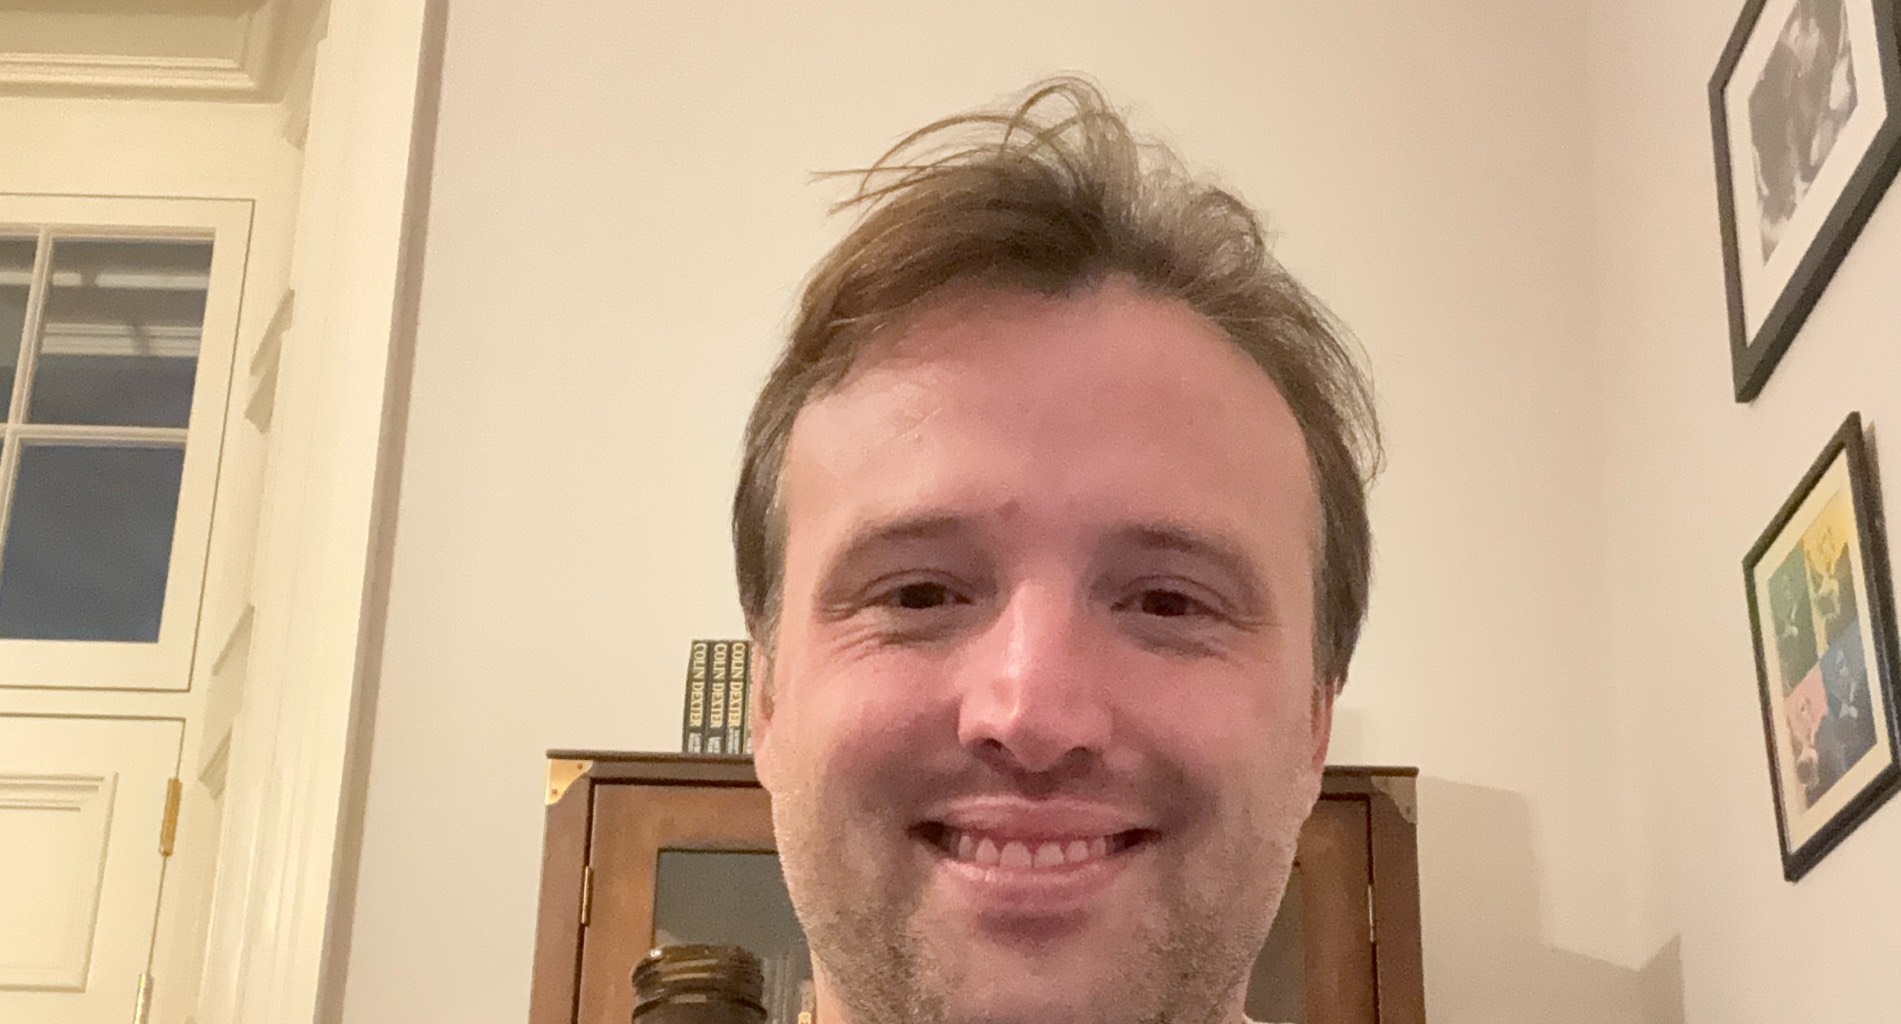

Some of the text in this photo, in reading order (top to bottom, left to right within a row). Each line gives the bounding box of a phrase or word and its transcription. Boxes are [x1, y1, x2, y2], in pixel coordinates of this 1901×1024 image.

[694, 643, 706, 678] COLIN
[713, 643, 726, 678] COLIN
[731, 643, 745, 678] COLIN
[691, 682, 704, 726] DEXTER
[710, 683, 724, 727] DEXTER
[728, 682, 742, 726] DEXTER
